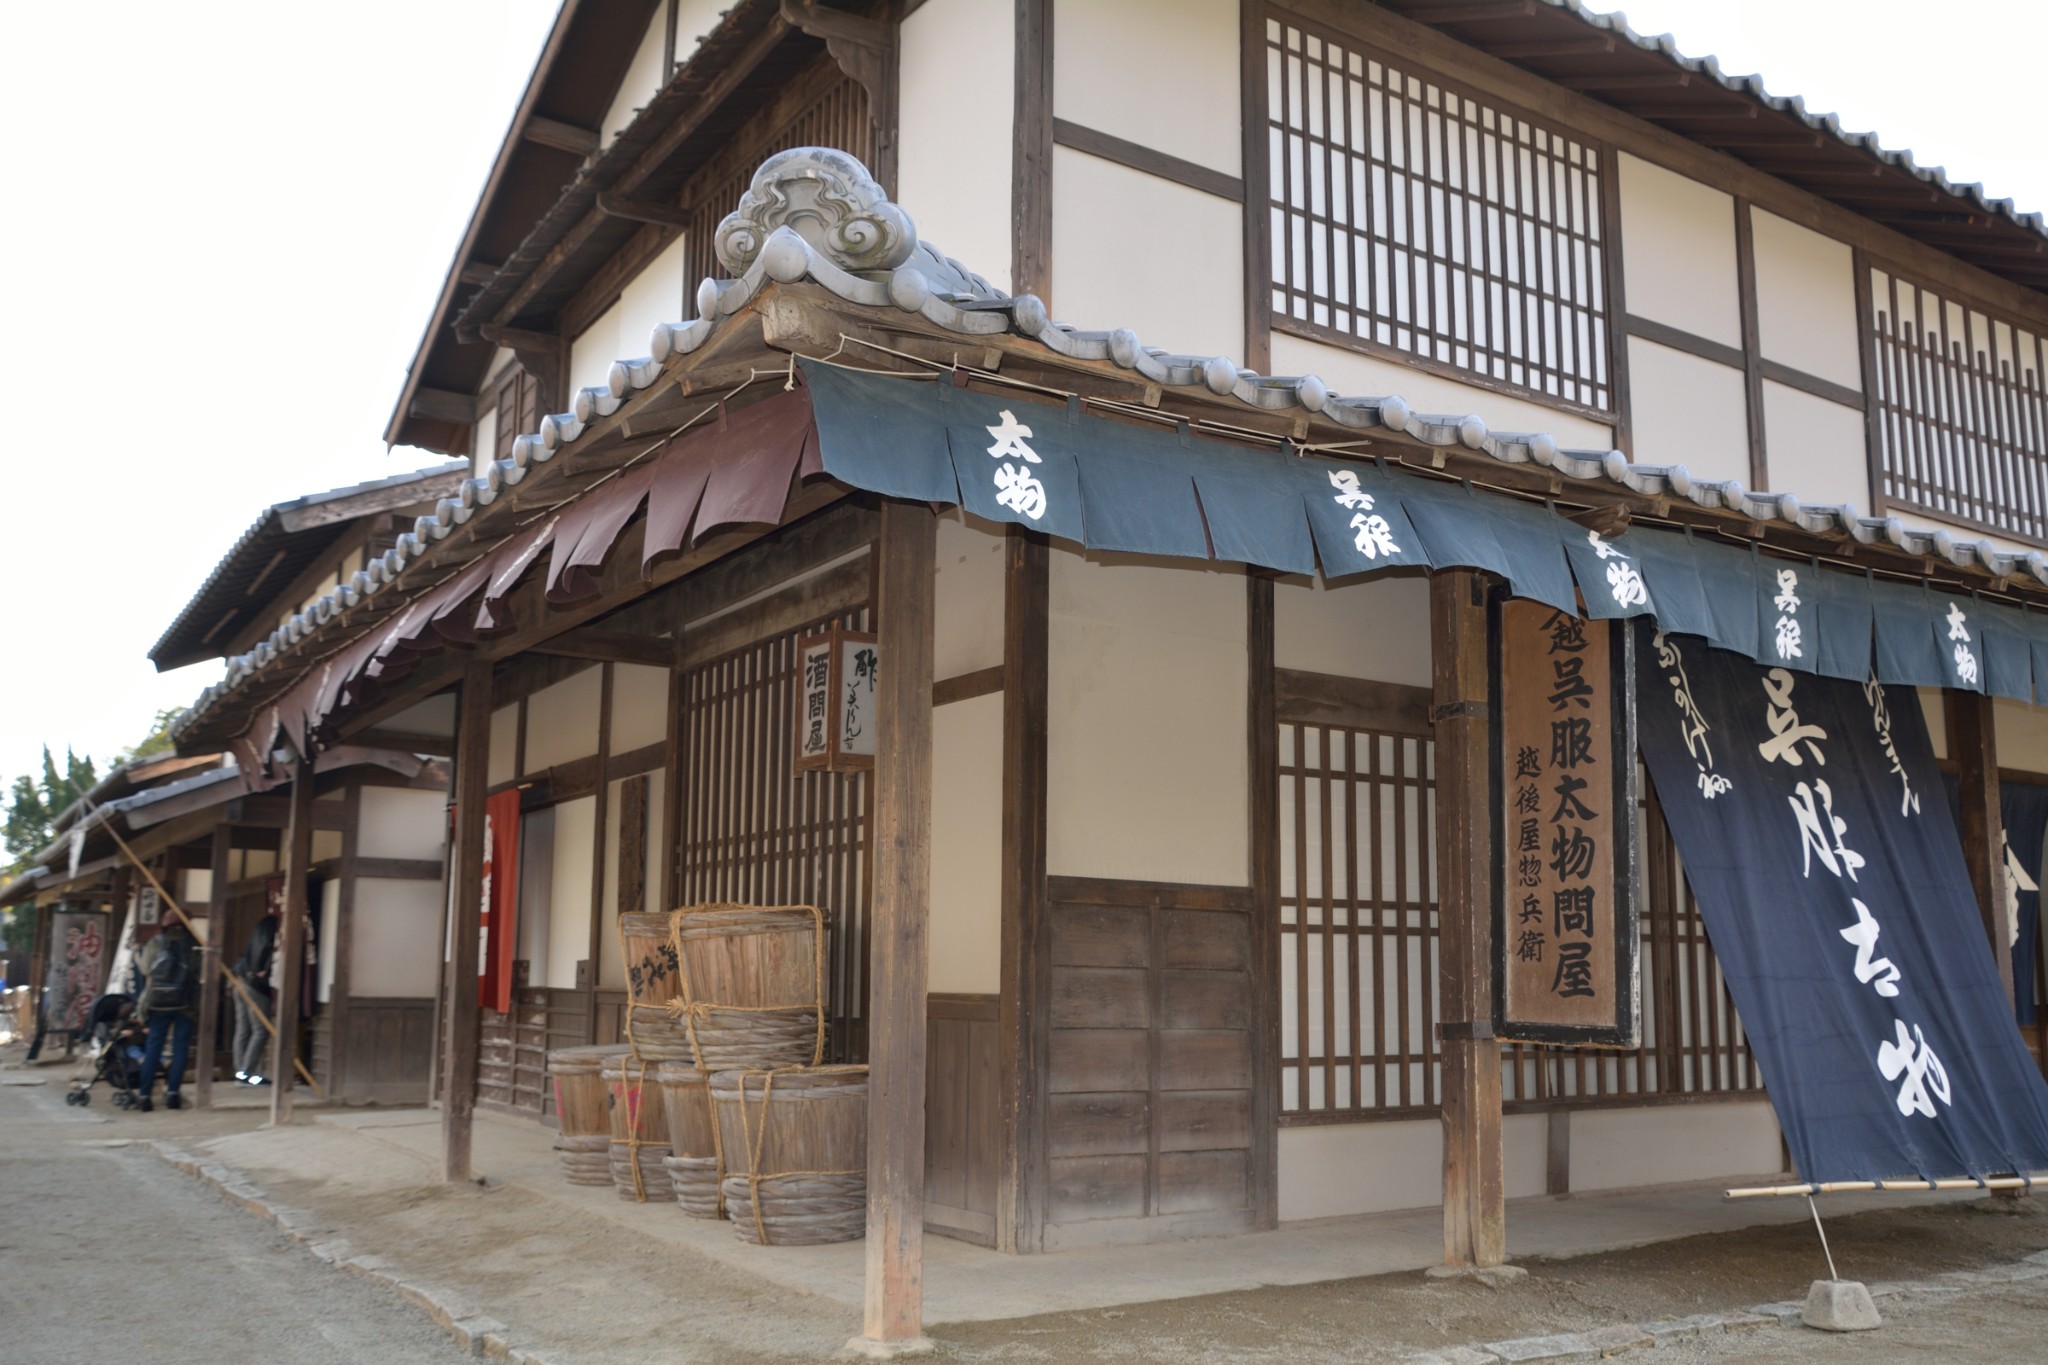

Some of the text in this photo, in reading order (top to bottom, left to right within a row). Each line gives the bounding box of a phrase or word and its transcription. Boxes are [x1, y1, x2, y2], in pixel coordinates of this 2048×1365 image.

[986, 409, 1047, 520] 太物
[1328, 469, 1402, 560] 呉服
[1774, 569, 1803, 658] 呉服
[1947, 602, 1978, 684] 太物
[804, 653, 830, 753] 酒問屋
